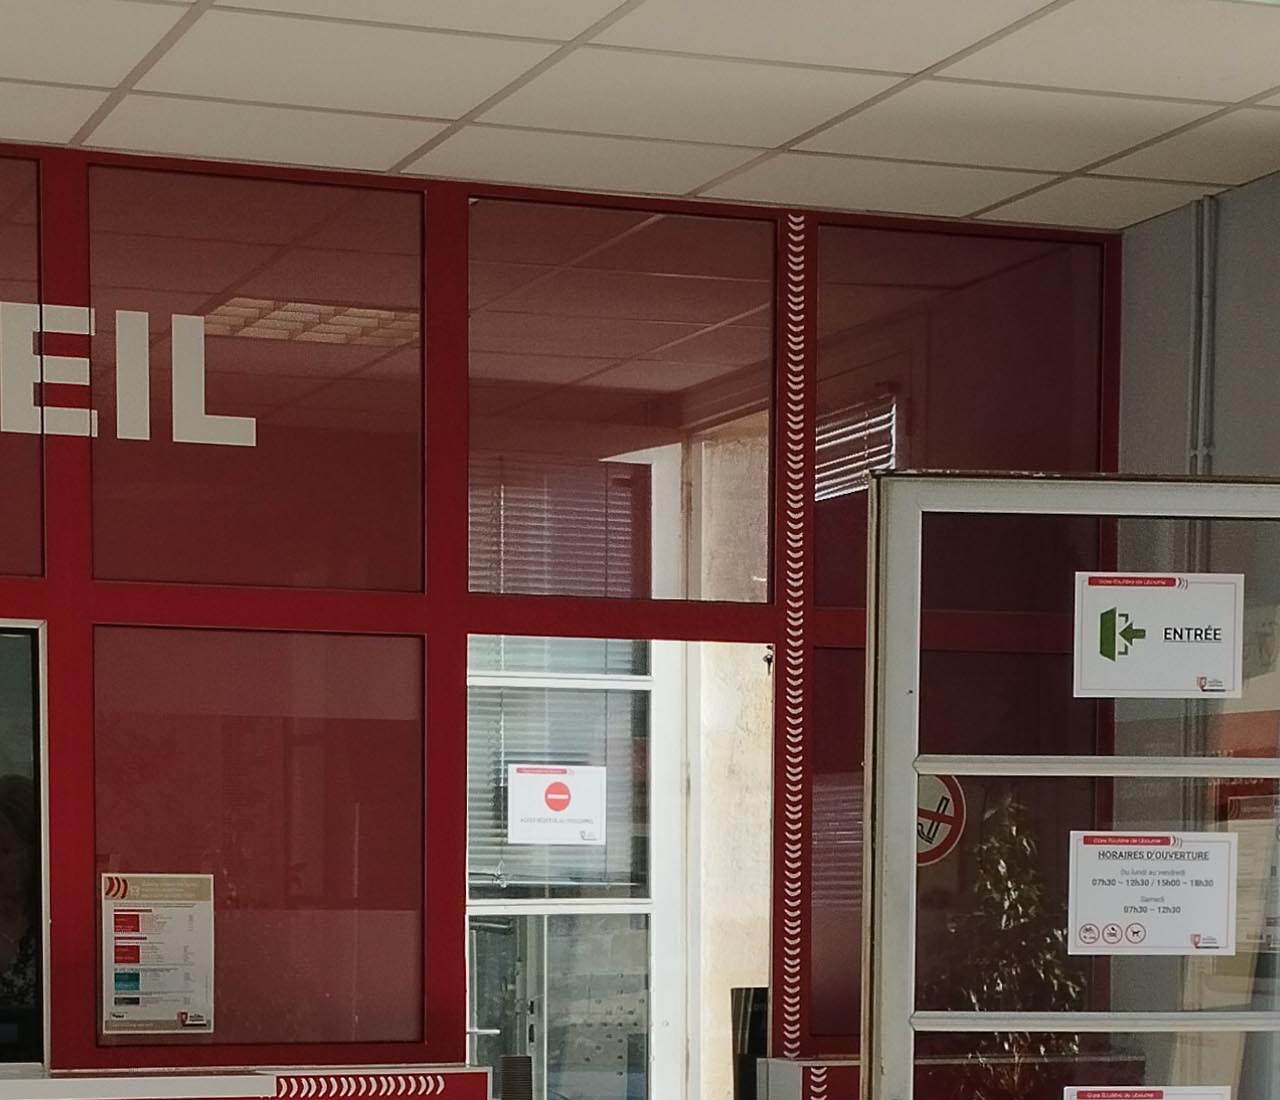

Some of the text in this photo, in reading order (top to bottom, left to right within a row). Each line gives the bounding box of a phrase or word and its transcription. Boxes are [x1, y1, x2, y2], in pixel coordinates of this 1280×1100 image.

[1163, 625, 1222, 641] ENTRÉE
[1098, 851, 1209, 861] HORAIRES D'OUVERTURE
